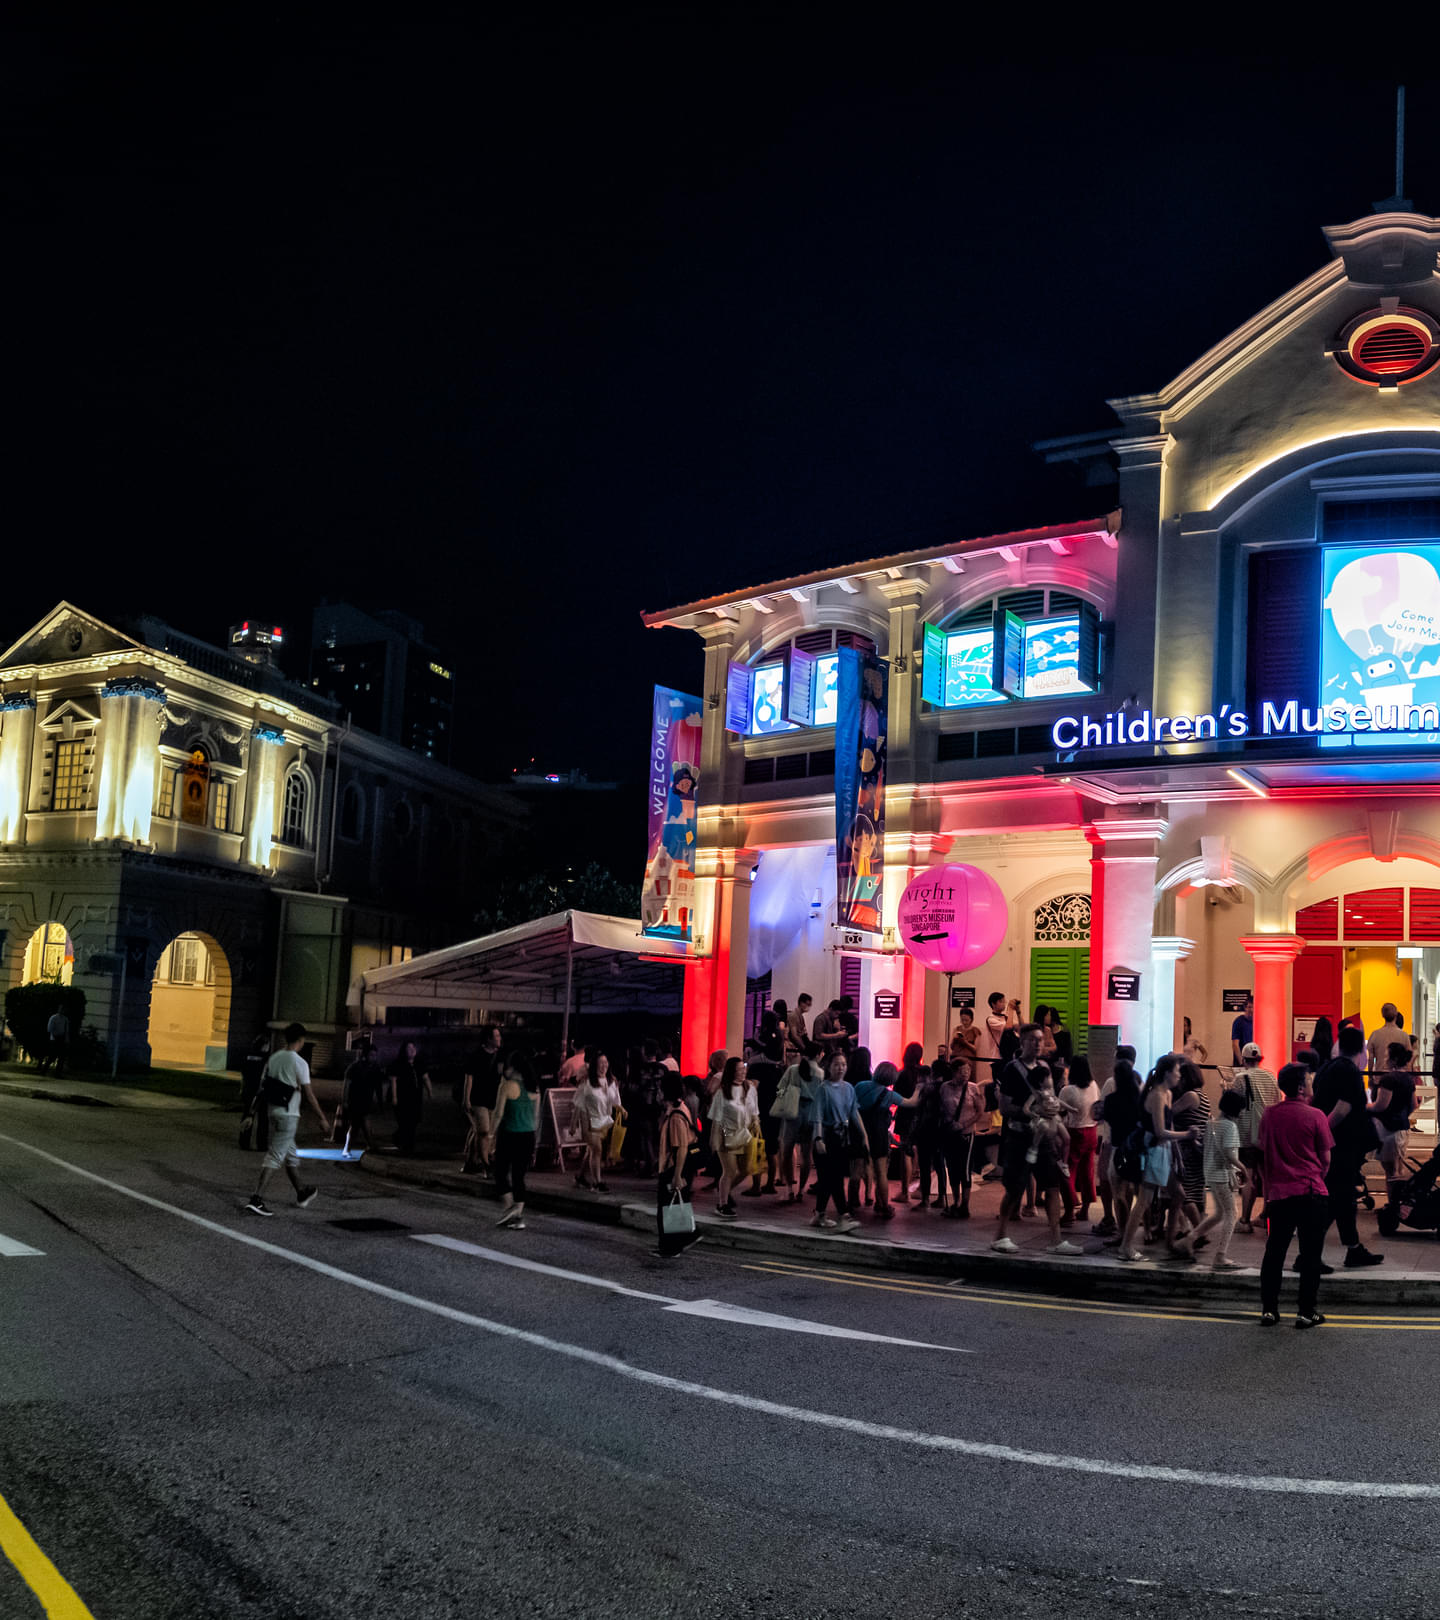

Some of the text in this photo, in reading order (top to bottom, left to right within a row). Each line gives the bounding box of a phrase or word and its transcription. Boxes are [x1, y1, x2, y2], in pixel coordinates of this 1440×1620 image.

[1401, 609, 1434, 623] Come
[1387, 620, 1415, 632] Join
[1052, 704, 1248, 749] Children's
[1262, 700, 1440, 734] Museum
[653, 715, 669, 816] WELCOME
[928, 913, 955, 922] MUSEUM
[911, 922, 941, 932] SINGAPORE
